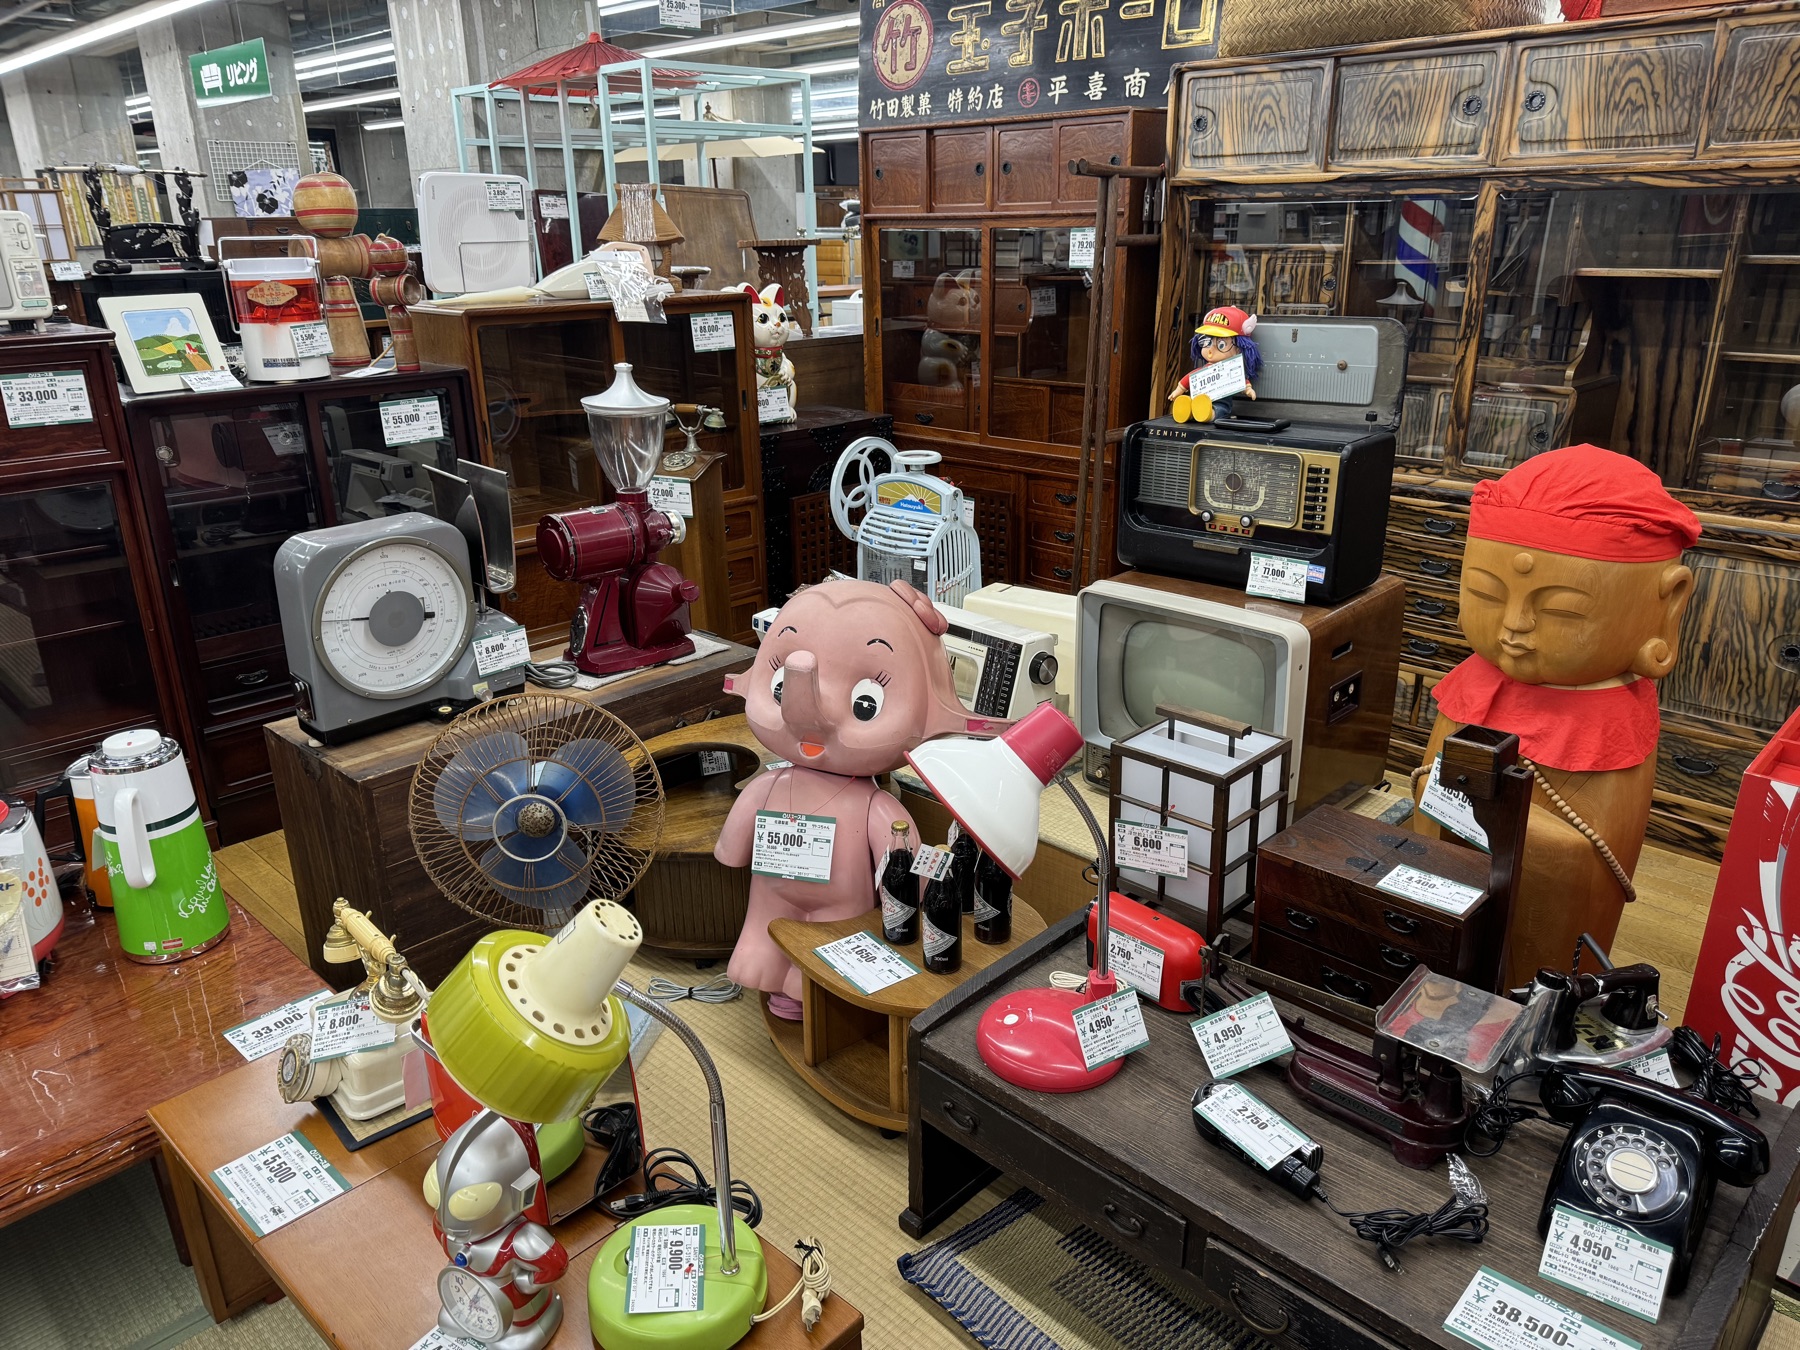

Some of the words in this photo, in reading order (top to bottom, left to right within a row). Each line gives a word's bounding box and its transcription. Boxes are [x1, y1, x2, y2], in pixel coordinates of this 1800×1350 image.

[881, 13, 922, 75] 竹
[225, 57, 258, 88] リビング
[1047, 67, 1170, 105] 平喜商
[869, 92, 932, 121] 竹田製菓
[947, 83, 1004, 114] 特約店
[1192, 383, 1198, 391] ¥
[1199, 372, 1223, 388] 11,000-
[5, 392, 15, 402] ¥
[18, 389, 58, 403] 33,000
[392, 413, 420, 425] 55,000
[1148, 428, 1188, 438] ZENITH
[651, 487, 674, 498] 22,000
[1252, 565, 1259, 573] ¥
[1263, 566, 1286, 579] 77,000
[757, 831, 765, 843] ¥
[767, 831, 807, 848] 55,000-
[1118, 834, 1125, 843] ¥
[1133, 836, 1162, 851] 6,600
[1405, 875, 1440, 891] 4,400-
[850, 944, 878, 965] 1,650-
[1109, 943, 1135, 961] 2,750-
[236, 1036, 249, 1045] ¥
[251, 1011, 308, 1039] 33,000-
[317, 1021, 327, 1032] ¥
[329, 1013, 363, 1031] 8,800-
[1079, 1026, 1088, 1038] ¥
[1088, 1015, 1115, 1034] 4,950-
[1201, 1037, 1212, 1049] ¥
[1213, 1023, 1246, 1044] 4,950-
[1221, 1092, 1232, 1101] ¥
[1236, 1105, 1269, 1131] 2,750
[1597, 1130, 1604, 1138] 5
[1617, 1126, 1624, 1134] 4
[1639, 1129, 1646, 1138] 3
[257, 1145, 275, 1157] ¥
[1583, 1142, 1590, 1150] 6
[1660, 1140, 1666, 1150] 2
[262, 1153, 297, 1184] 5,500
[1582, 1178, 1589, 1187] 8
[670, 1227, 683, 1236] ¥
[1582, 1229, 1604, 1241] 600-A
[1553, 1228, 1565, 1242] ¥
[1569, 1234, 1617, 1261] 4,950-
[1640, 1243, 1660, 1255] 黒電話
[668, 1240, 684, 1275] 9,900-
[1541, 1294, 1584, 1322] リユース品
[1472, 1288, 1491, 1305] ¥
[1491, 1299, 1575, 1349] 38,500-
[1602, 1336, 1618, 1348] 文机
